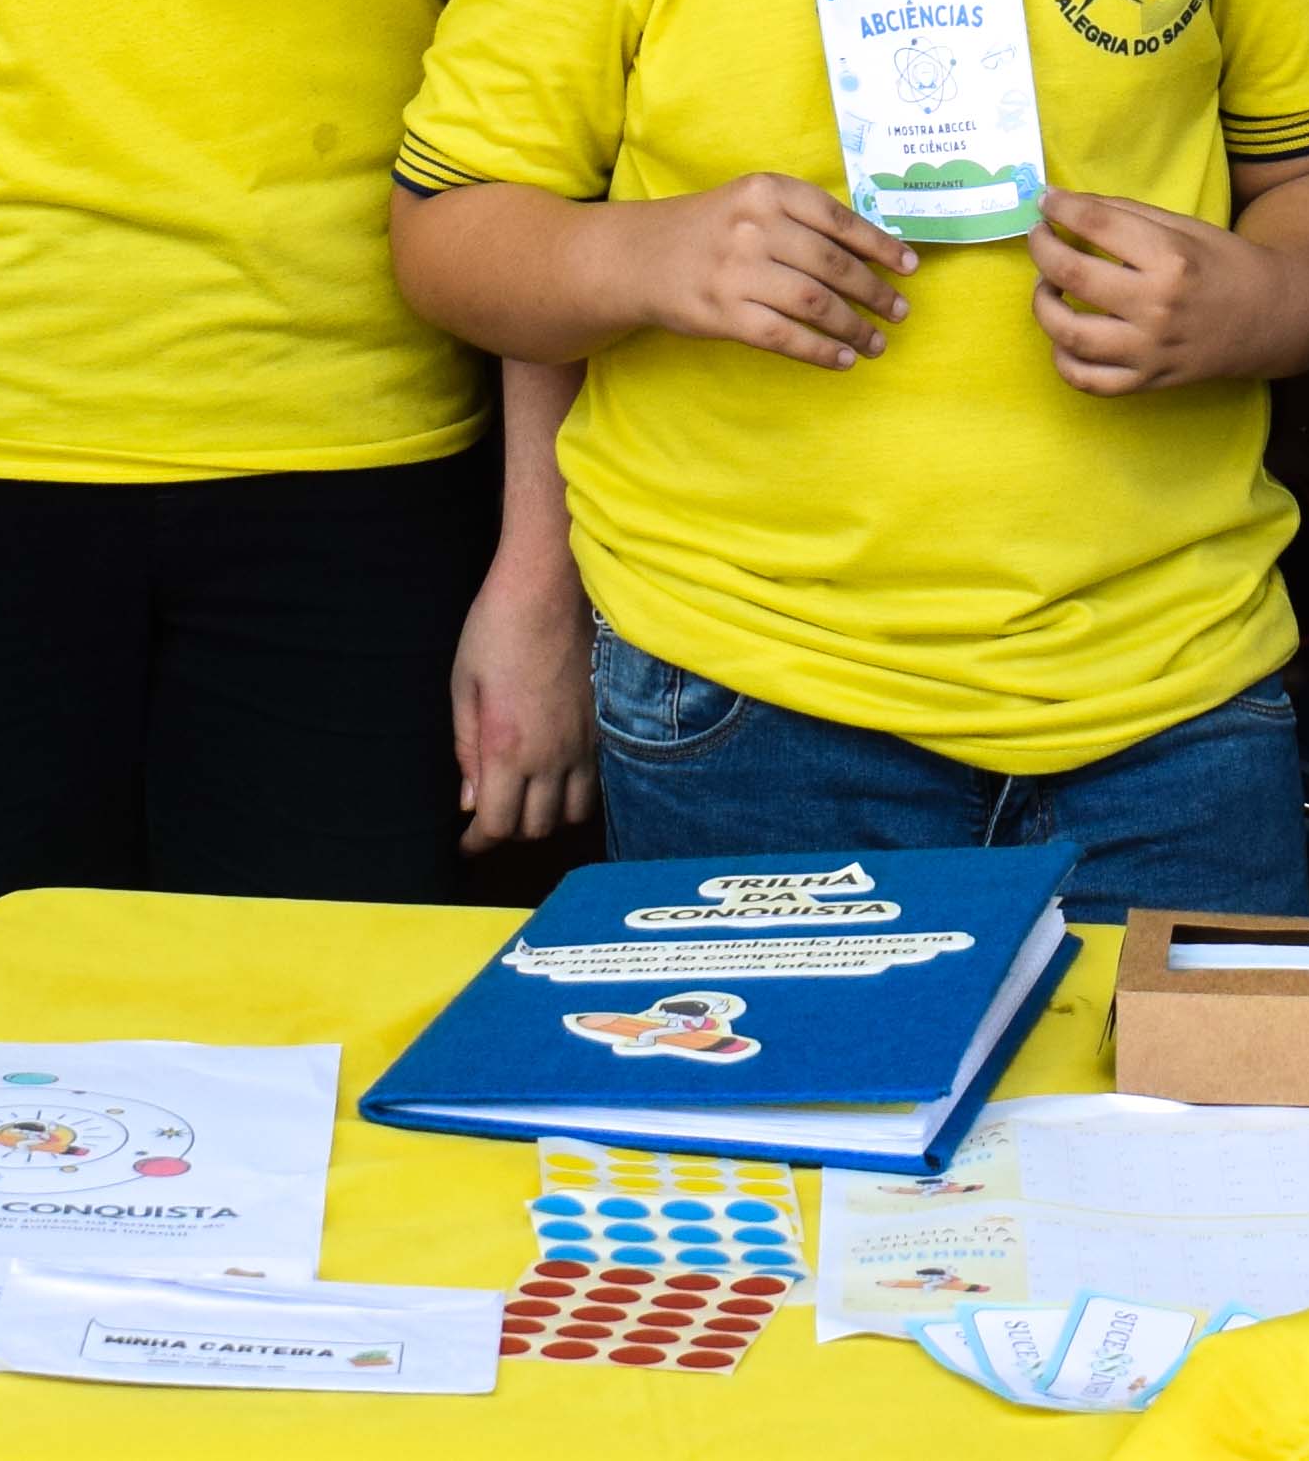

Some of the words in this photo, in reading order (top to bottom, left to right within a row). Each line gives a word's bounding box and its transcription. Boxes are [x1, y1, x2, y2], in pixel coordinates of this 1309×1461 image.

[1133, 35, 1161, 57] DO
[892, 123, 935, 137] MOSTRA
[903, 143, 916, 155] DE
[918, 139, 967, 155] CIÊNCIAS
[718, 872, 859, 889] TRILHA
[742, 891, 798, 903] DA
[640, 902, 887, 922] CONQUISTA
[569, 947, 585, 956] e
[675, 938, 831, 951] caminhando
[835, 935, 917, 948] juntos
[922, 934, 954, 944] na
[665, 953, 697, 963] do
[703, 947, 918, 962] comportamento
[569, 968, 585, 976] e
[590, 966, 622, 975] da
[628, 964, 766, 974] autonomia
[1, 1201, 240, 1220] CONQUISTA
[103, 1334, 188, 1350] MINHA
[199, 1341, 335, 1358] CARTEIRA
